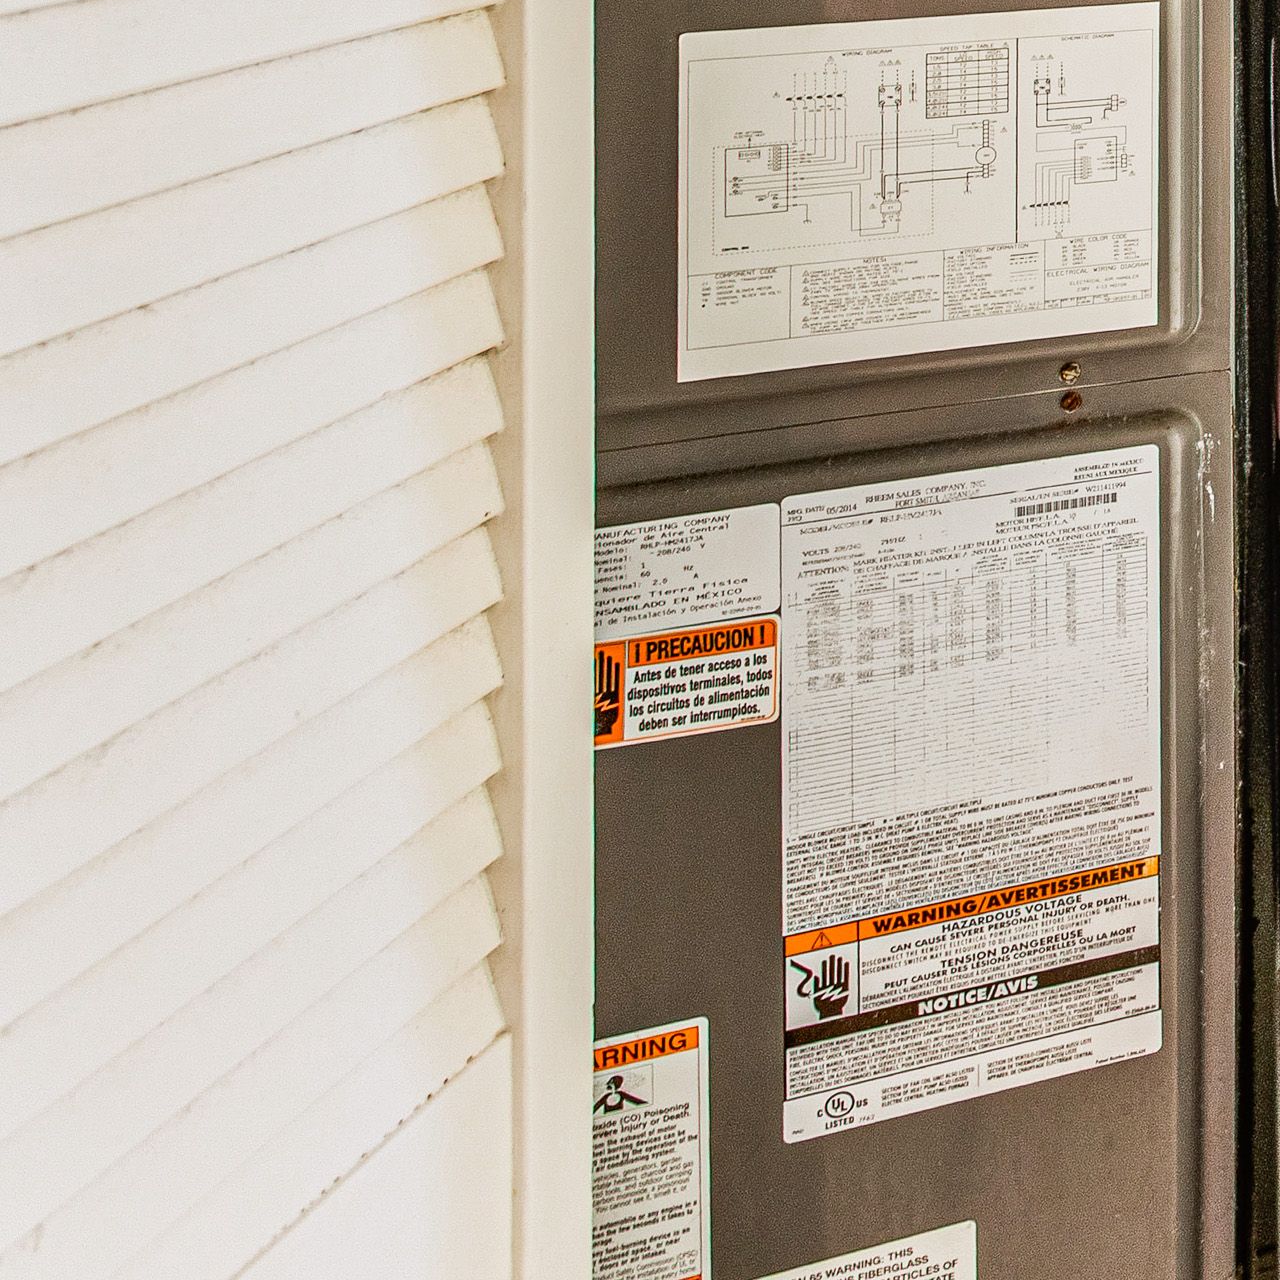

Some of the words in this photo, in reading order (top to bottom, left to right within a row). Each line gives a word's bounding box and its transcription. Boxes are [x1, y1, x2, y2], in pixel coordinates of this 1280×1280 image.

[826, 503, 857, 514] 05/2014
[896, 489, 921, 499] SALES
[684, 514, 731, 527] COMPANY
[649, 585, 695, 598] Tierra
[673, 596, 689, 605] EN
[646, 627, 754, 661] PRECAUCION
[633, 667, 661, 684] Antes
[665, 668, 676, 678] de
[680, 663, 706, 676] tener
[708, 657, 742, 671] acceso
[745, 657, 750, 666] a
[753, 653, 767, 664] los
[627, 681, 686, 702] dispositivos
[690, 673, 744, 690] terminales,
[747, 669, 772, 682] todos
[629, 704, 644, 717] los
[647, 697, 690, 712] circuitos
[694, 696, 705, 706] de
[708, 684, 770, 703] alimentación
[639, 716, 668, 731] deben
[671, 715, 686, 726] ser
[690, 703, 760, 723] interrumpidos.
[873, 862, 1146, 933] WARNING/AVERTISSEMENT
[890, 942, 911, 953] CAN
[915, 935, 947, 947] CAUSE
[950, 928, 984, 940] SEVERE
[988, 912, 1039, 932] PERSONAL
[1042, 906, 1077, 918] INJURY
[1080, 902, 1093, 910] OR
[1096, 894, 1130, 907] DEATH.
[942, 908, 1021, 933] HAZARDOUS
[1026, 894, 1082, 914] VOLTAGE
[884, 977, 907, 989] PEUT
[912, 970, 947, 983] CAUSER
[951, 966, 968, 974] DES
[1014, 938, 1076, 959] CORPORELLES
[1079, 936, 1093, 944] OU
[1110, 926, 1137, 937] MORT
[941, 948, 997, 968] TENSION
[1001, 929, 1083, 955] DANGEREUSE
[918, 975, 1039, 1015] NOTICE/AVIS
[825, 1116, 855, 1130] LISTED
[826, 1256, 885, 1278] WARNING:
[888, 1247, 914, 1260] THIS
[858, 1256, 929, 1280] FIBERGLASS
[943, 1259, 959, 1270] OF
